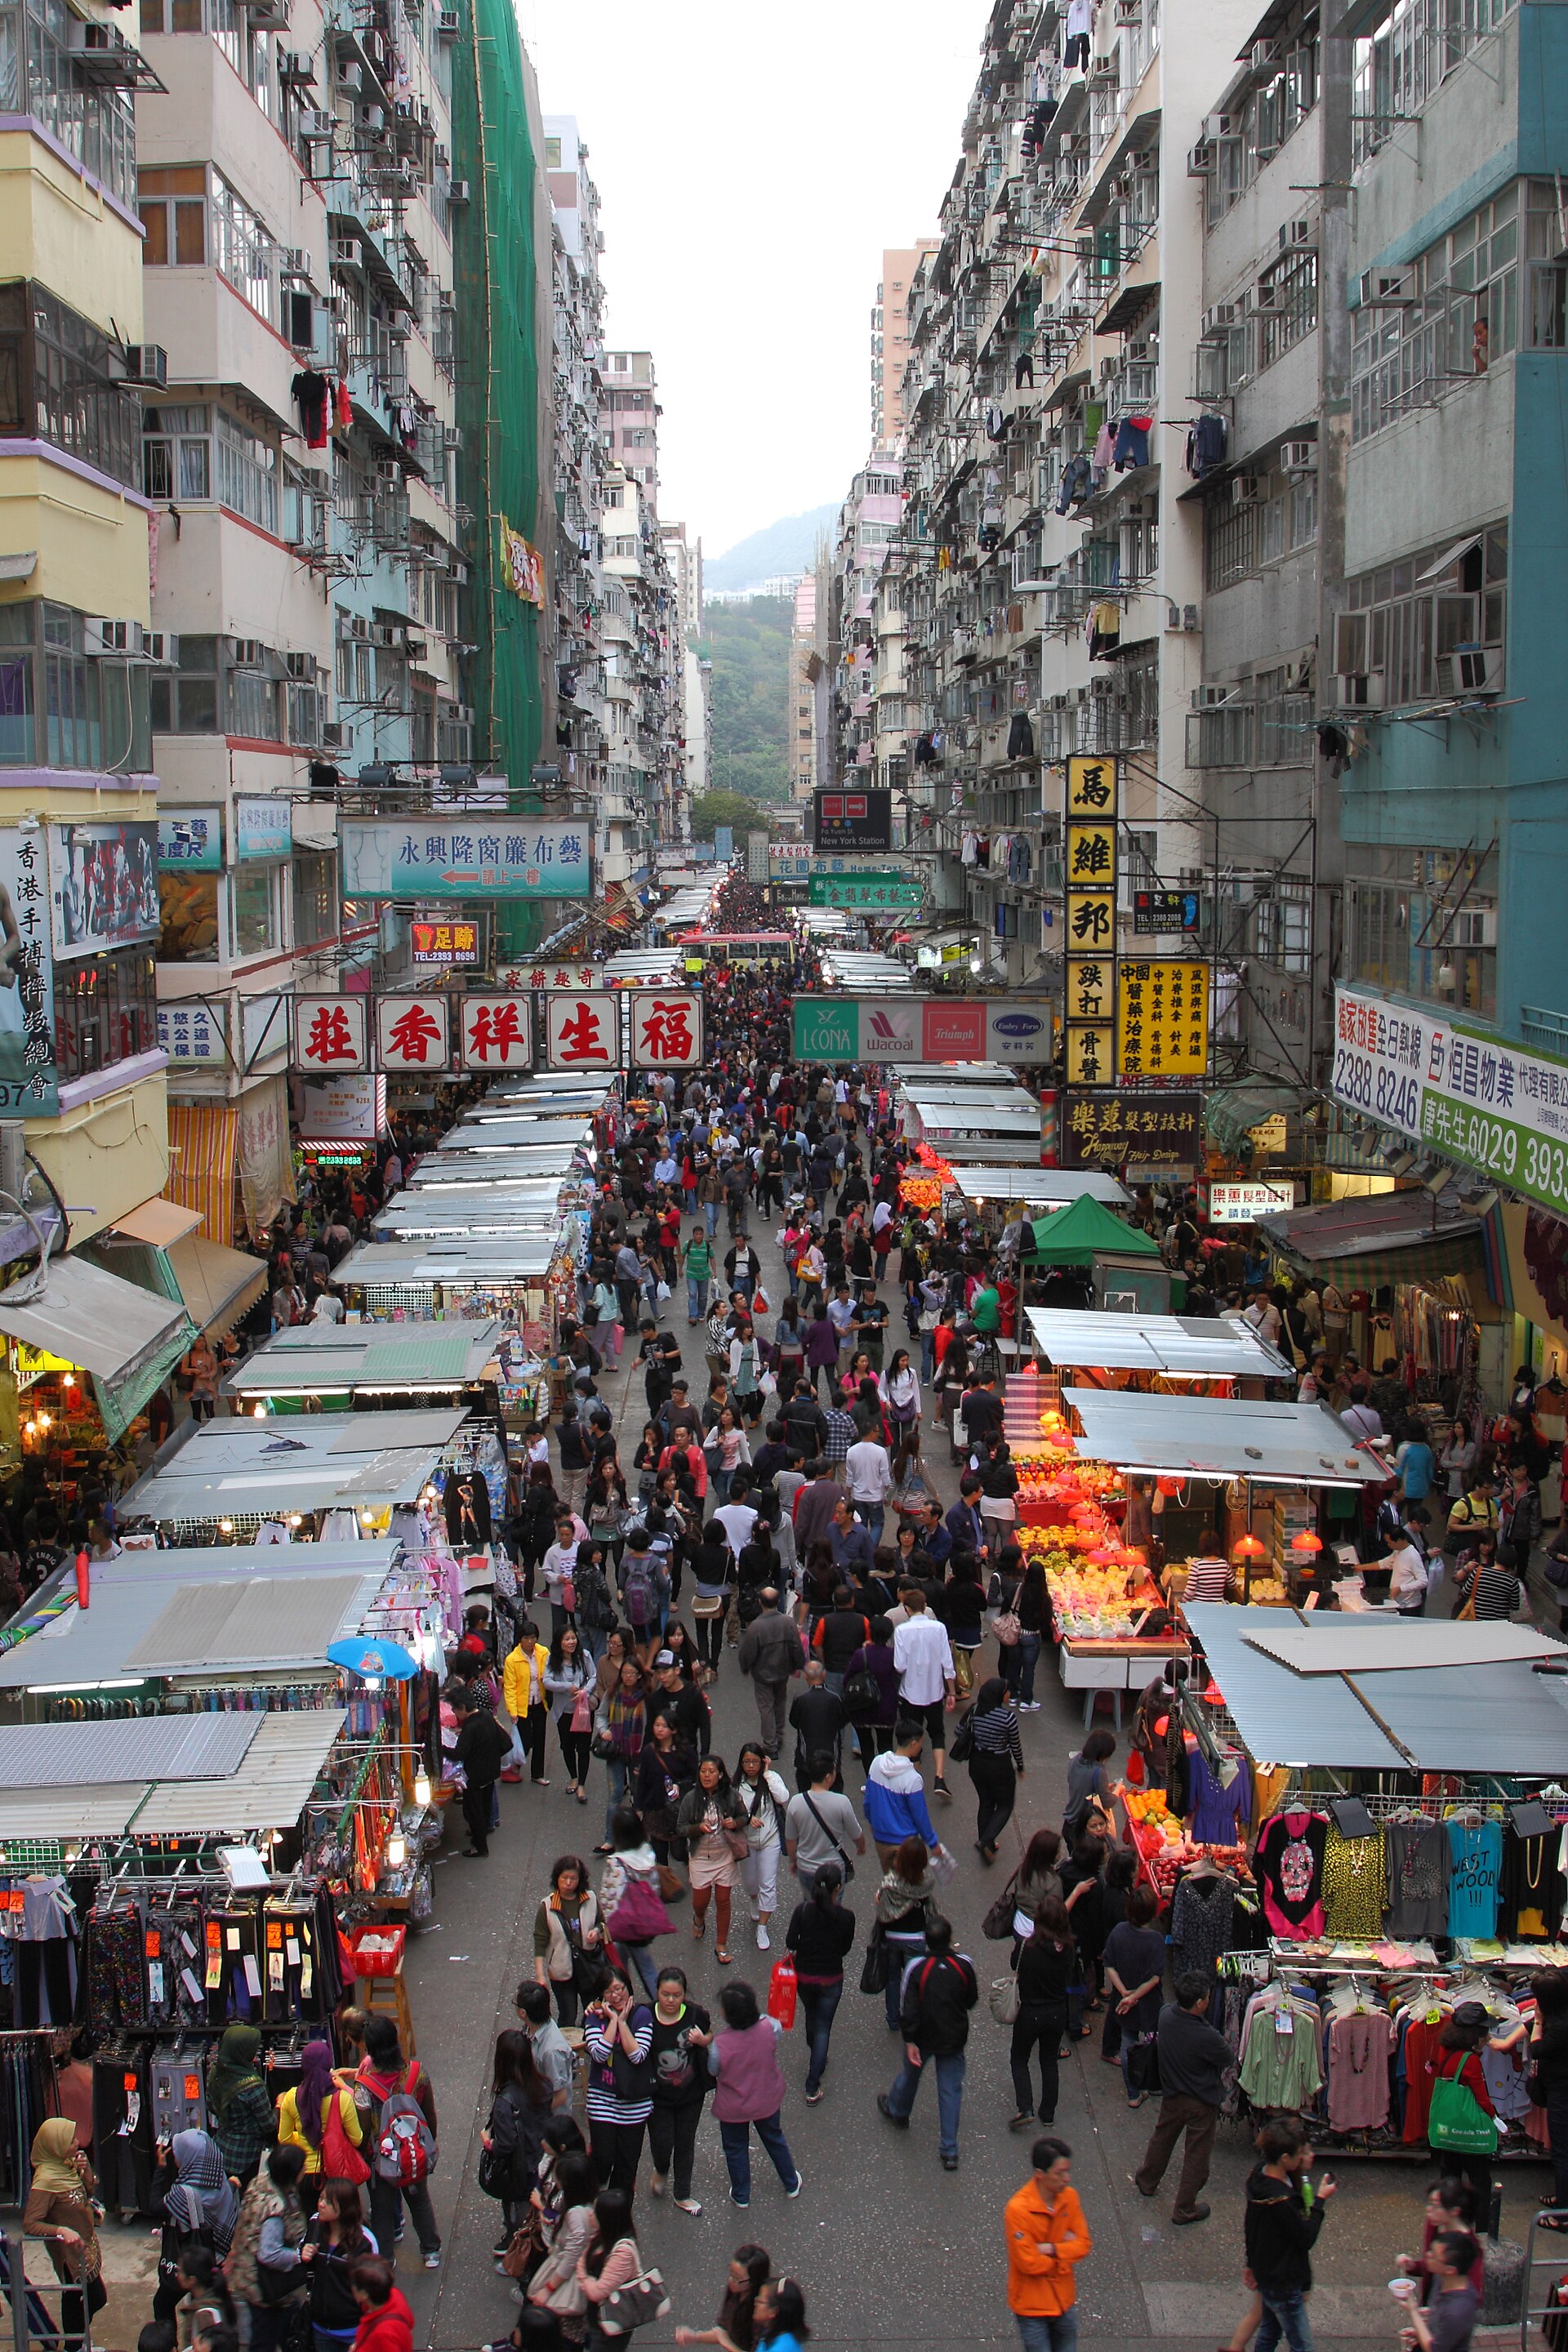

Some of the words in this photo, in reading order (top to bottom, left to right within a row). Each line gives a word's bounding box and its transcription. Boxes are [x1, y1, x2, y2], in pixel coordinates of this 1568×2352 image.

[399, 834, 582, 866] 永興隆窗簾布藝
[779, 859, 845, 873] 花園布藝
[482, 868, 541, 885] 請上一樓
[828, 888, 901, 903] 金翡翠布藝
[434, 926, 474, 950] 足跡
[998, 1022, 1018, 1031] Embry
[1022, 1022, 1040, 1031] Form
[934, 1028, 974, 1041] Triumph
[867, 1039, 913, 1050] Wacoal
[1001, 1041, 1035, 1050] 安莉芳
[1335, 1048, 1372, 1108] 2388
[1377, 1066, 1419, 1130] 8246
[1468, 1115, 1517, 1175] 6029
[1129, 1151, 1150, 1162] Hair
[1152, 1150, 1180, 1162] Design
[1452, 1851, 1490, 1876] WEST
